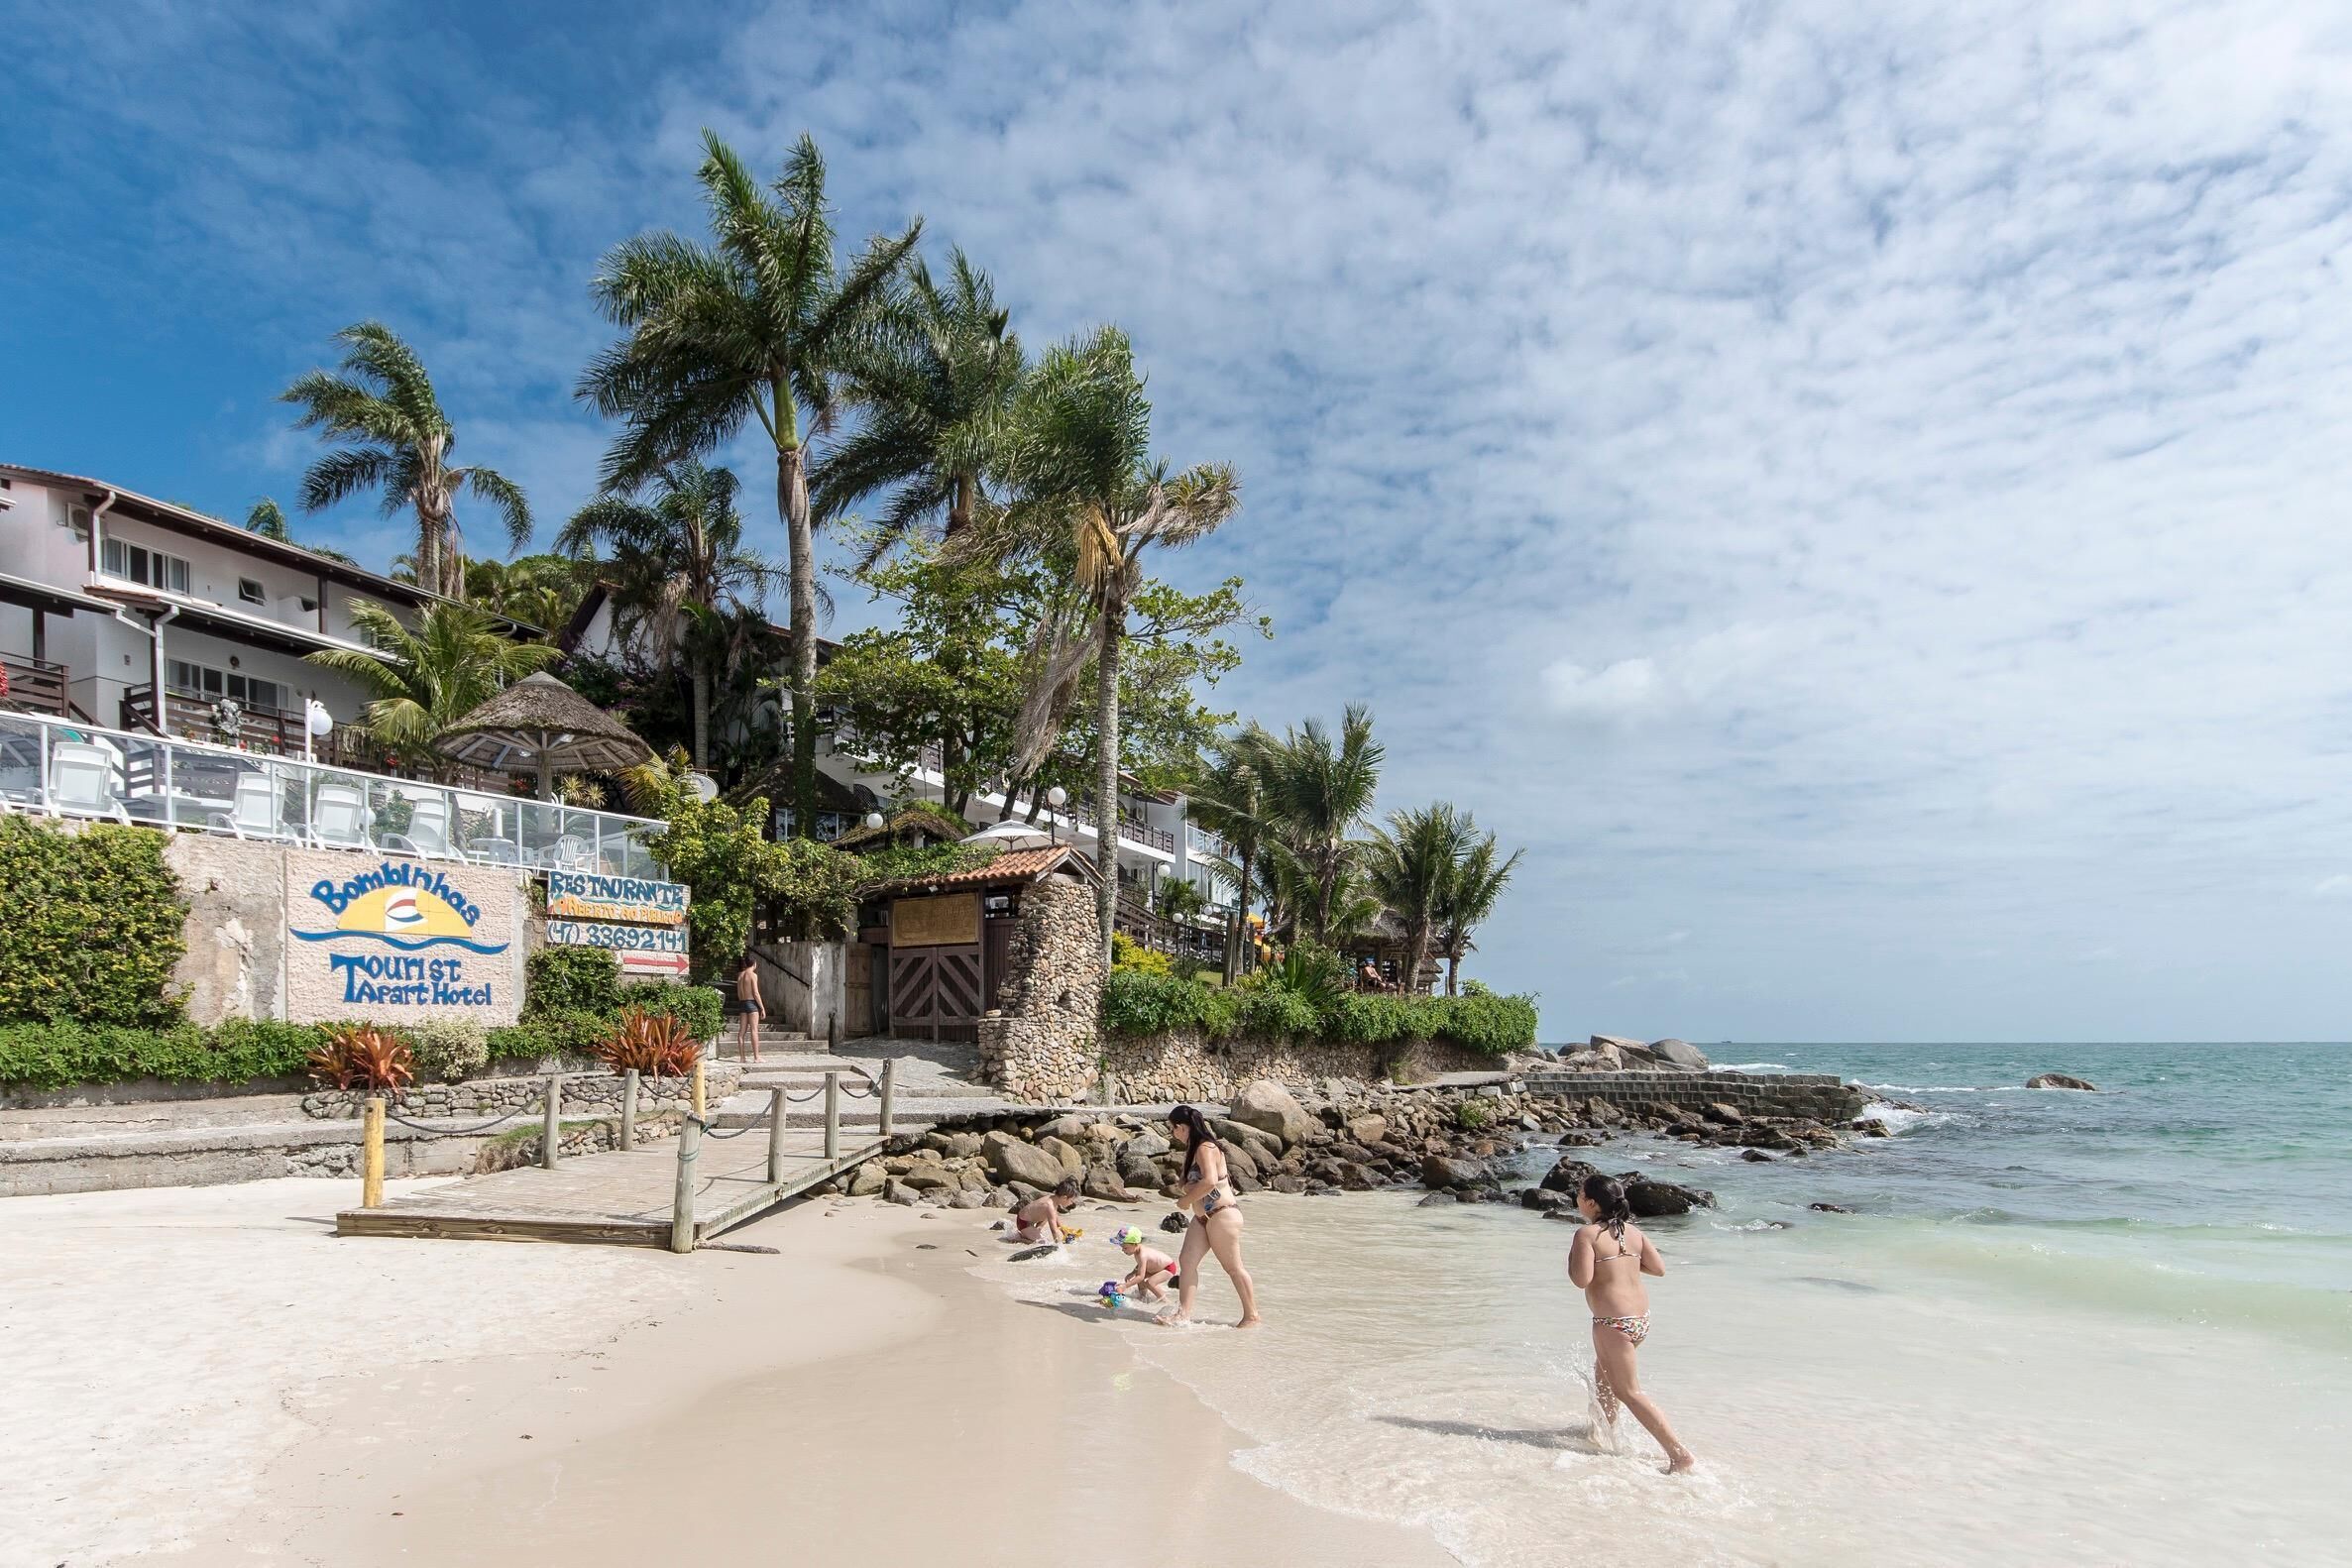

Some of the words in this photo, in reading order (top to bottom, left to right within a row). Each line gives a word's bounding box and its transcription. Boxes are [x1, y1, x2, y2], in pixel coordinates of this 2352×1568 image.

[310, 861, 481, 928] Bombinhas
[550, 871, 684, 905] RESTAURANTE
[568, 896, 615, 919] ABERTO
[620, 907, 636, 920] AO
[548, 922, 581, 945] (47)
[586, 924, 686, 952] 33692141
[329, 952, 462, 1003] Tourist
[355, 979, 429, 1006] Apart
[431, 981, 493, 1006] Hotel
